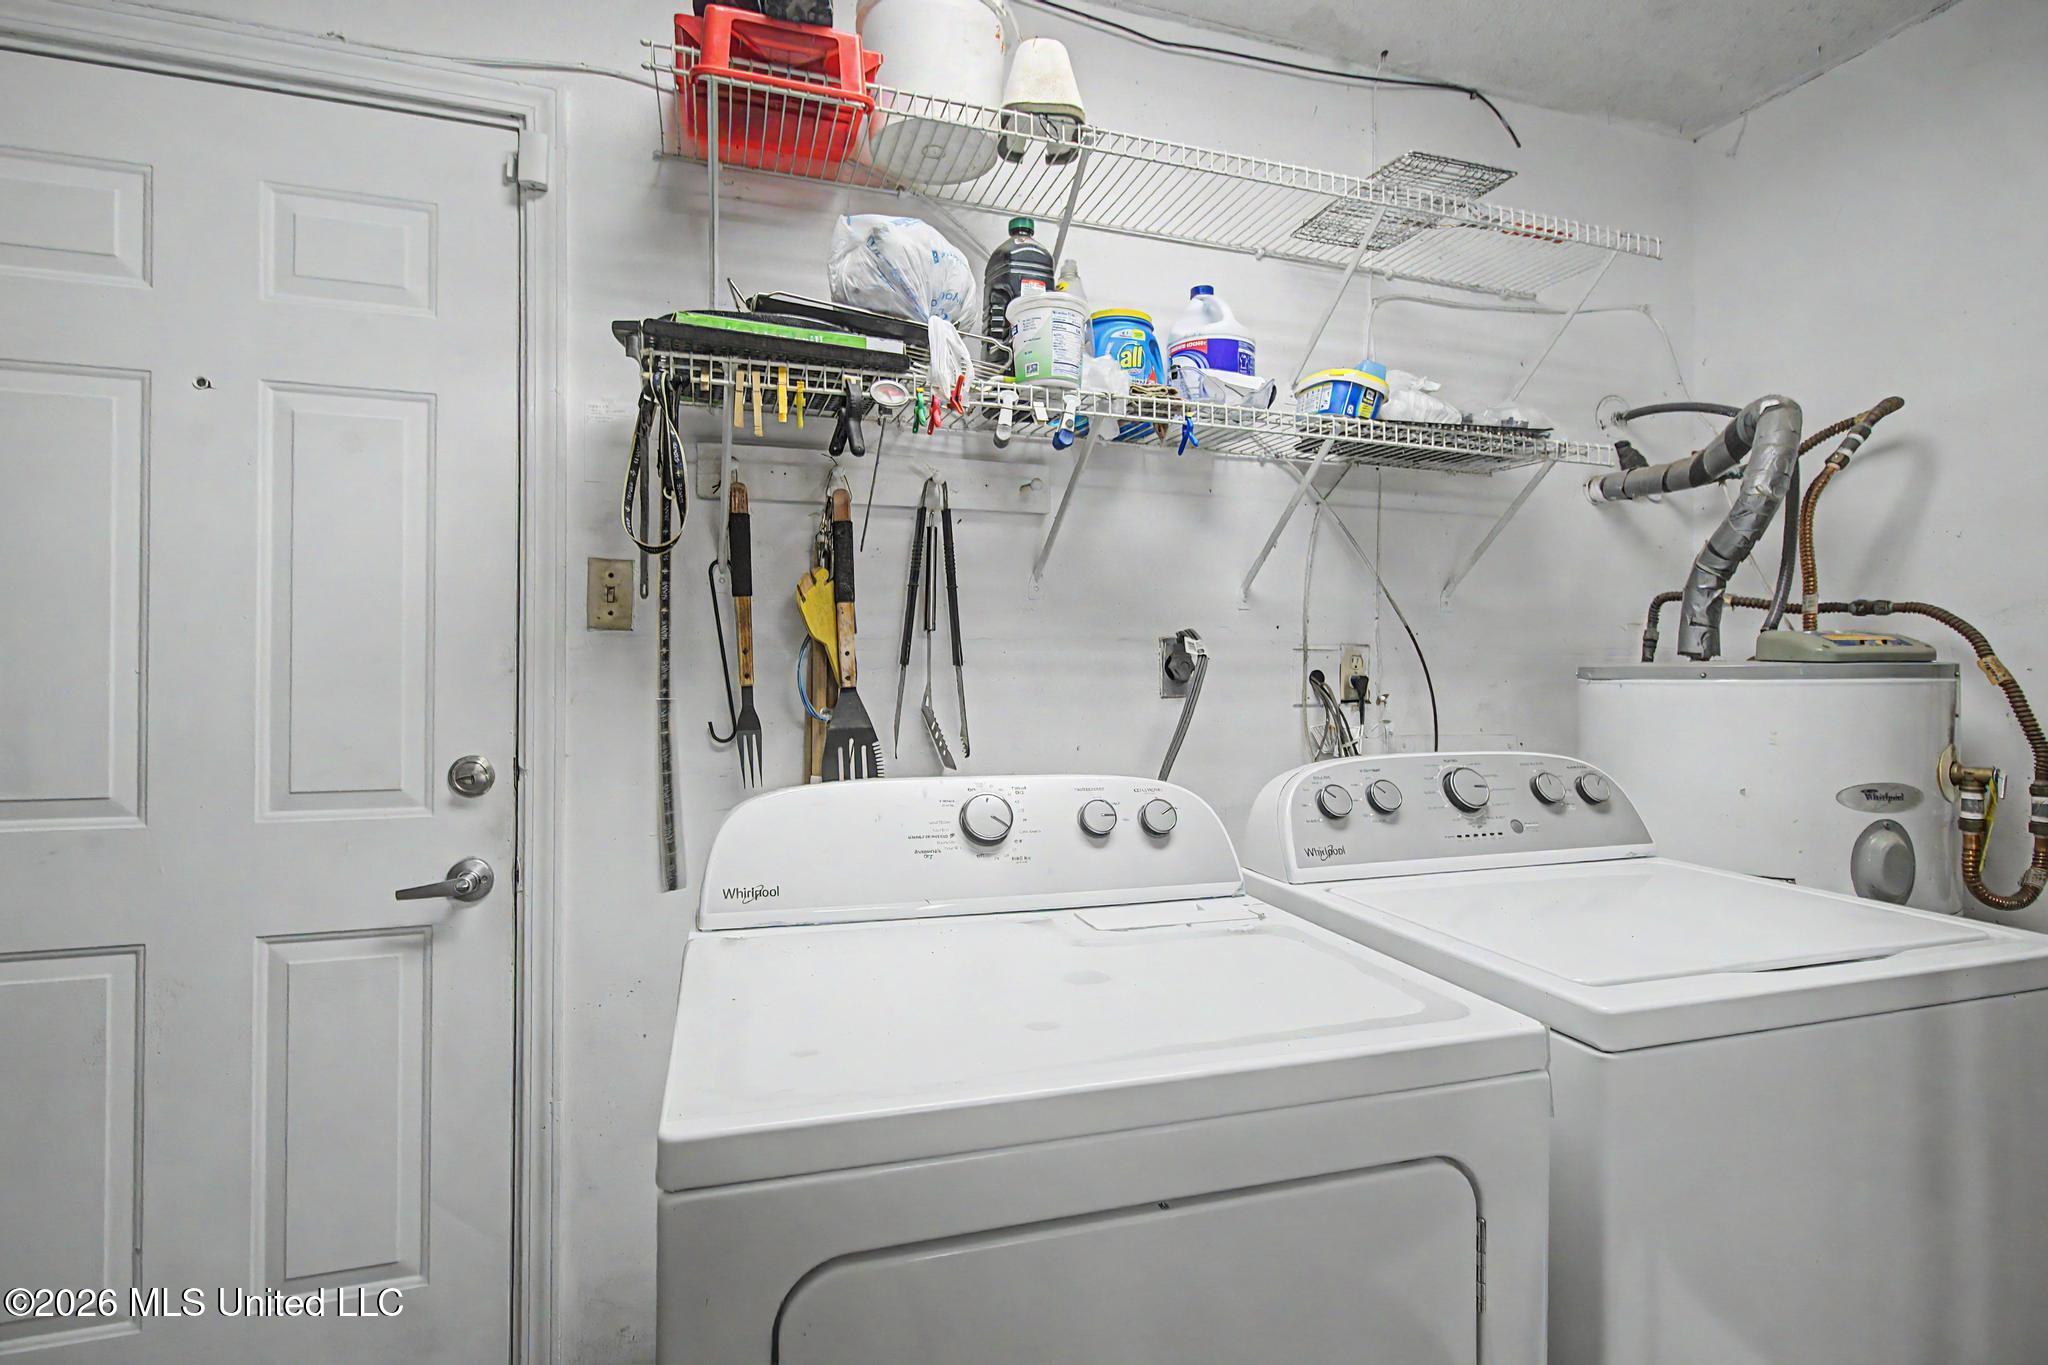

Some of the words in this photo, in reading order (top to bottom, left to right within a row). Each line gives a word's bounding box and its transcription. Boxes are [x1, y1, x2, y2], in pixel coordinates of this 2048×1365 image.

[1120, 345, 1143, 368] all
[1304, 844, 1345, 861] Whirlpool
[722, 884, 780, 904] Whirlpool
